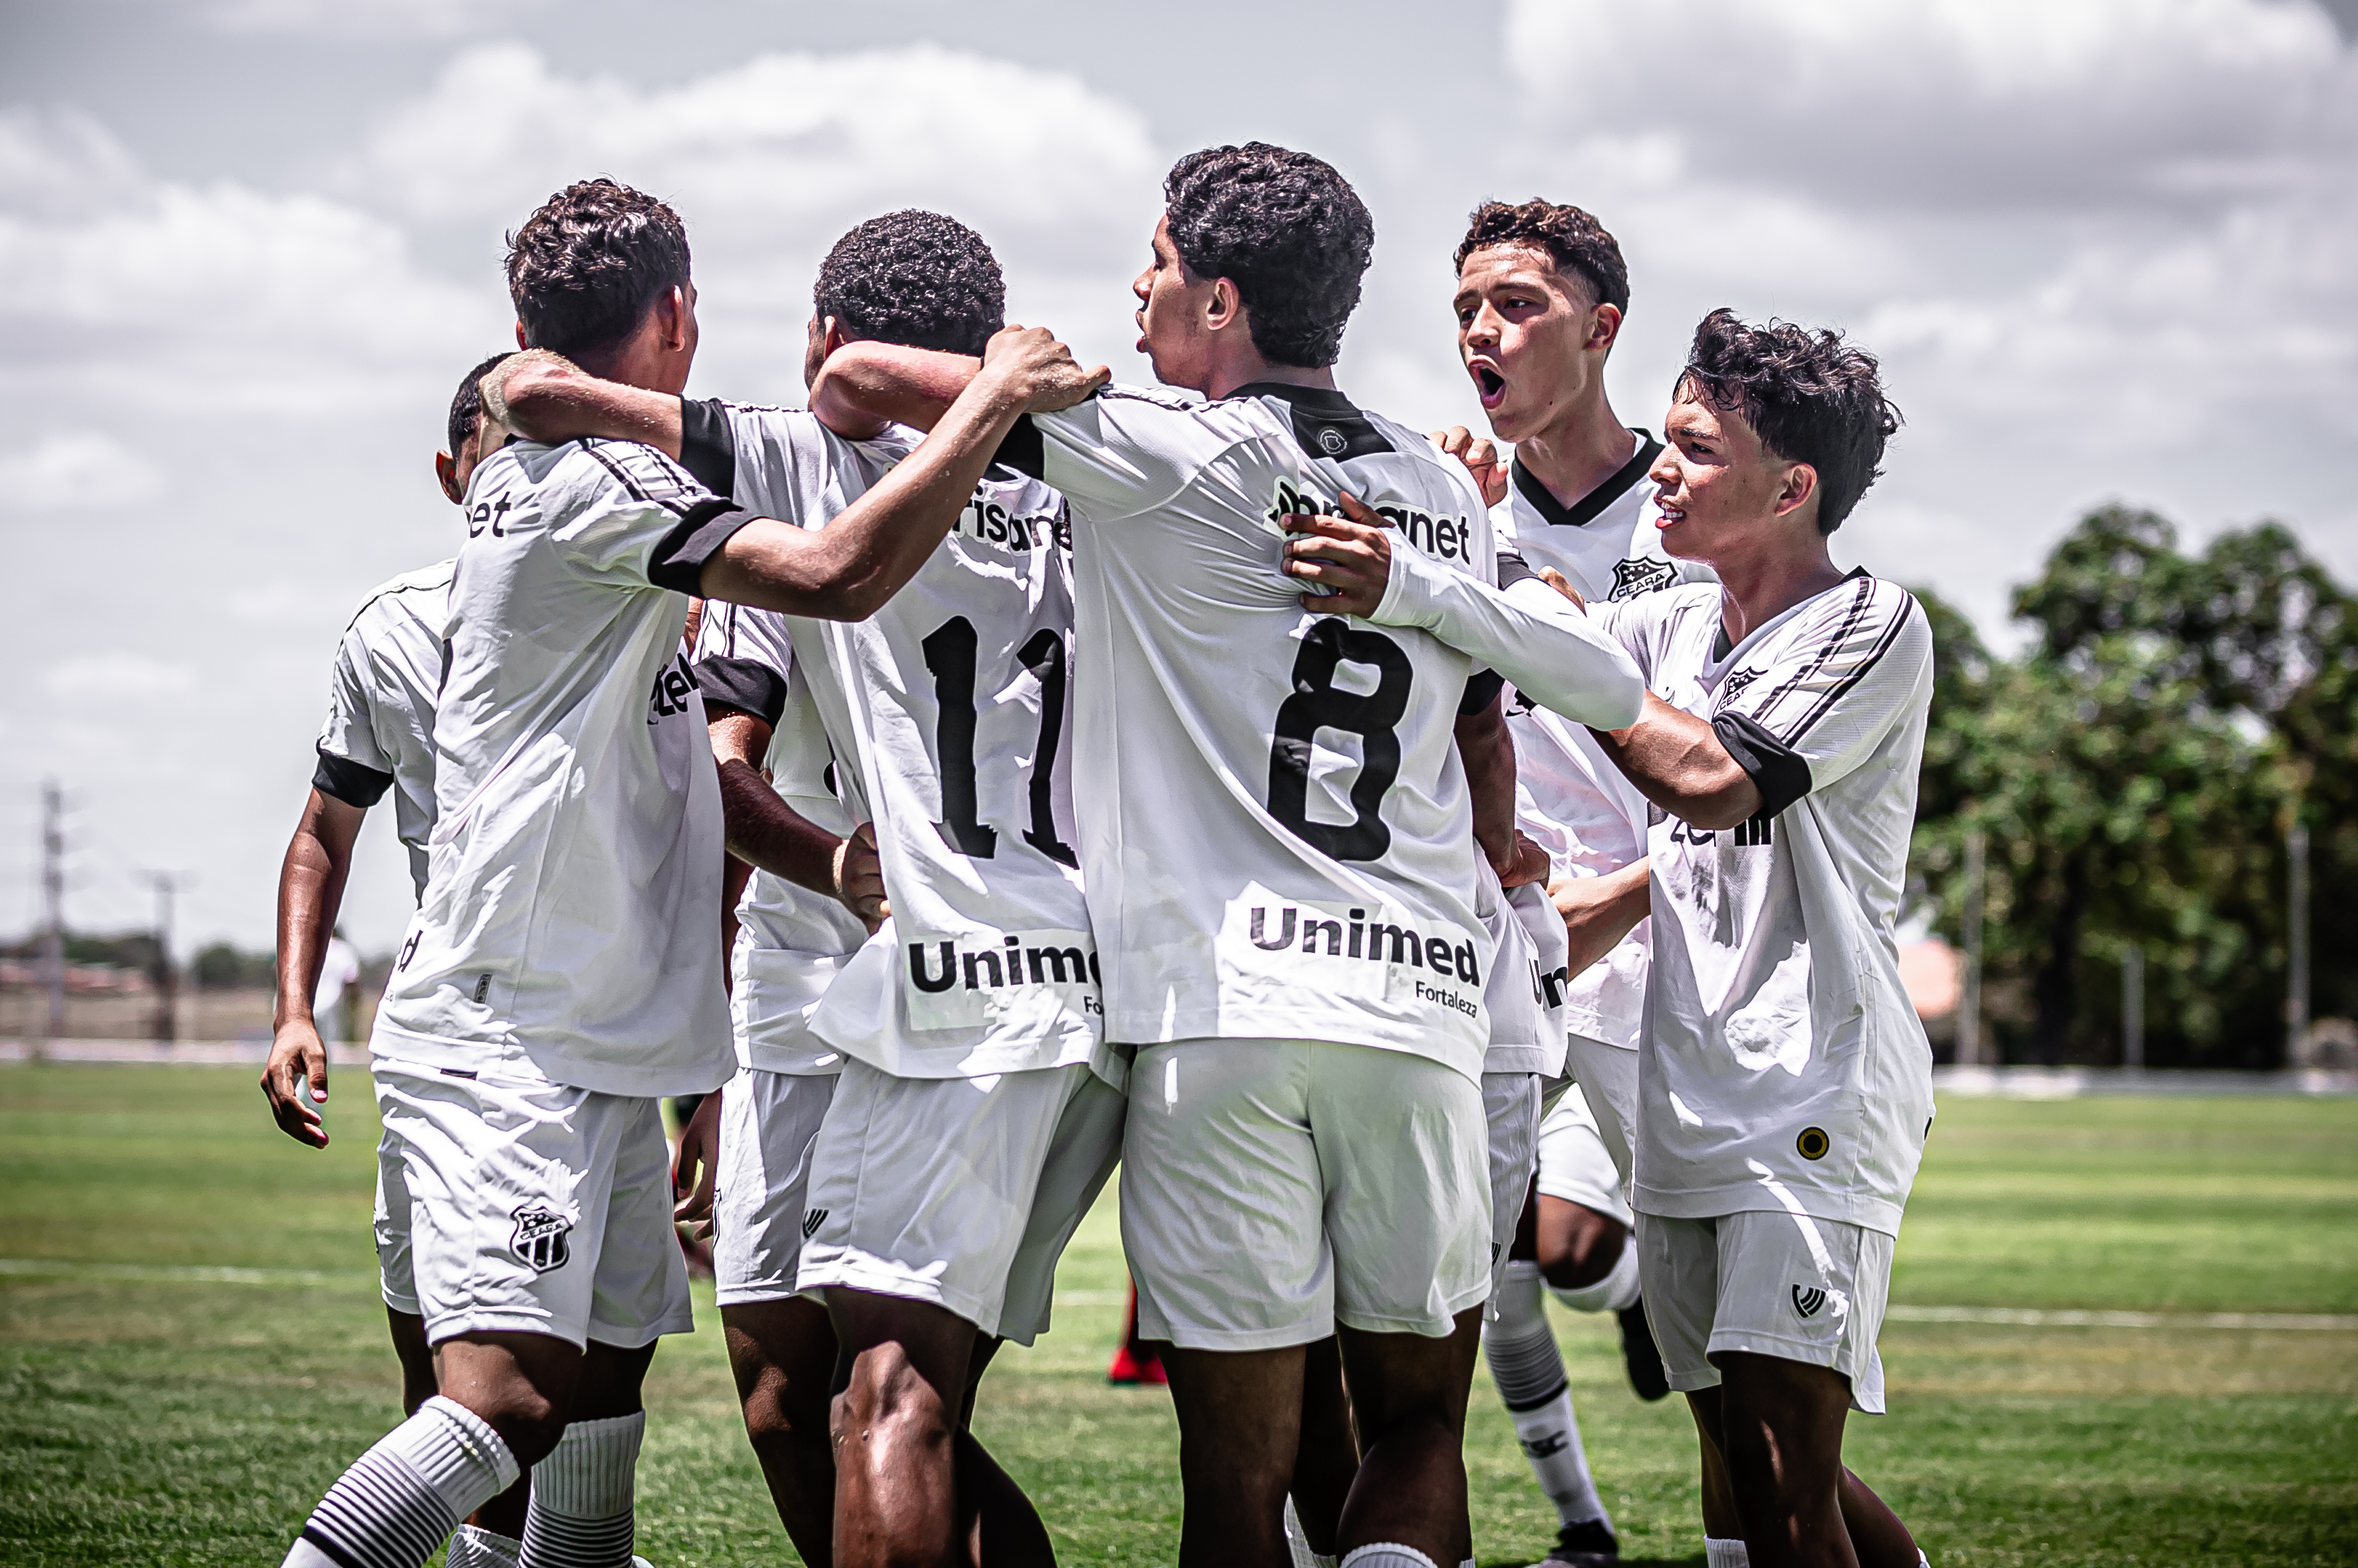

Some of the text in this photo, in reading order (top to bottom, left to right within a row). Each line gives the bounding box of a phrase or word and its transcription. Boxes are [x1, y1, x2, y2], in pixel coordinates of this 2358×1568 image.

[921, 615, 1081, 870] 11
[1267, 617, 1413, 862] 8
[1251, 907, 1480, 987] Unimed
[1415, 980, 1478, 1019] Fortaleza
